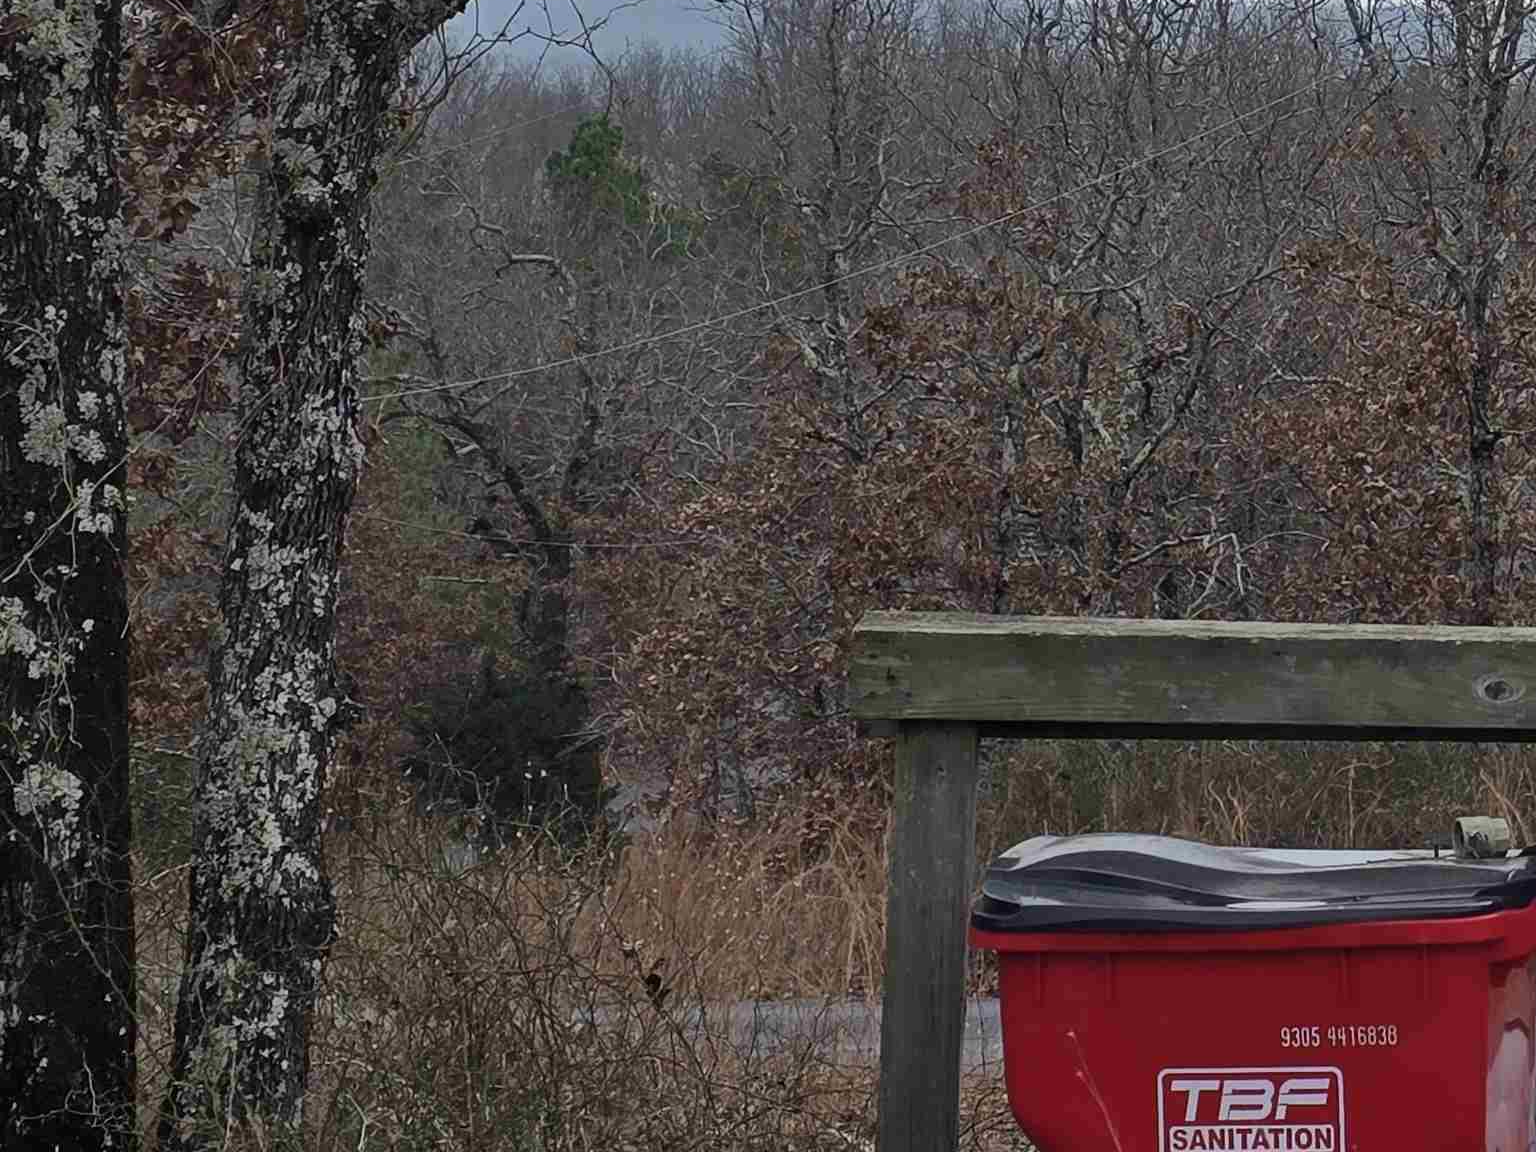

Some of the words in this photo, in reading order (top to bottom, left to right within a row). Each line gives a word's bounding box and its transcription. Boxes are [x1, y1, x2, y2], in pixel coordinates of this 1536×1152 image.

[1280, 1026, 1320, 1047] 9305
[1327, 1025, 1398, 1047] 4416838
[1170, 1078, 1331, 1122] TBF
[1172, 1127, 1332, 1150] SANITATION
